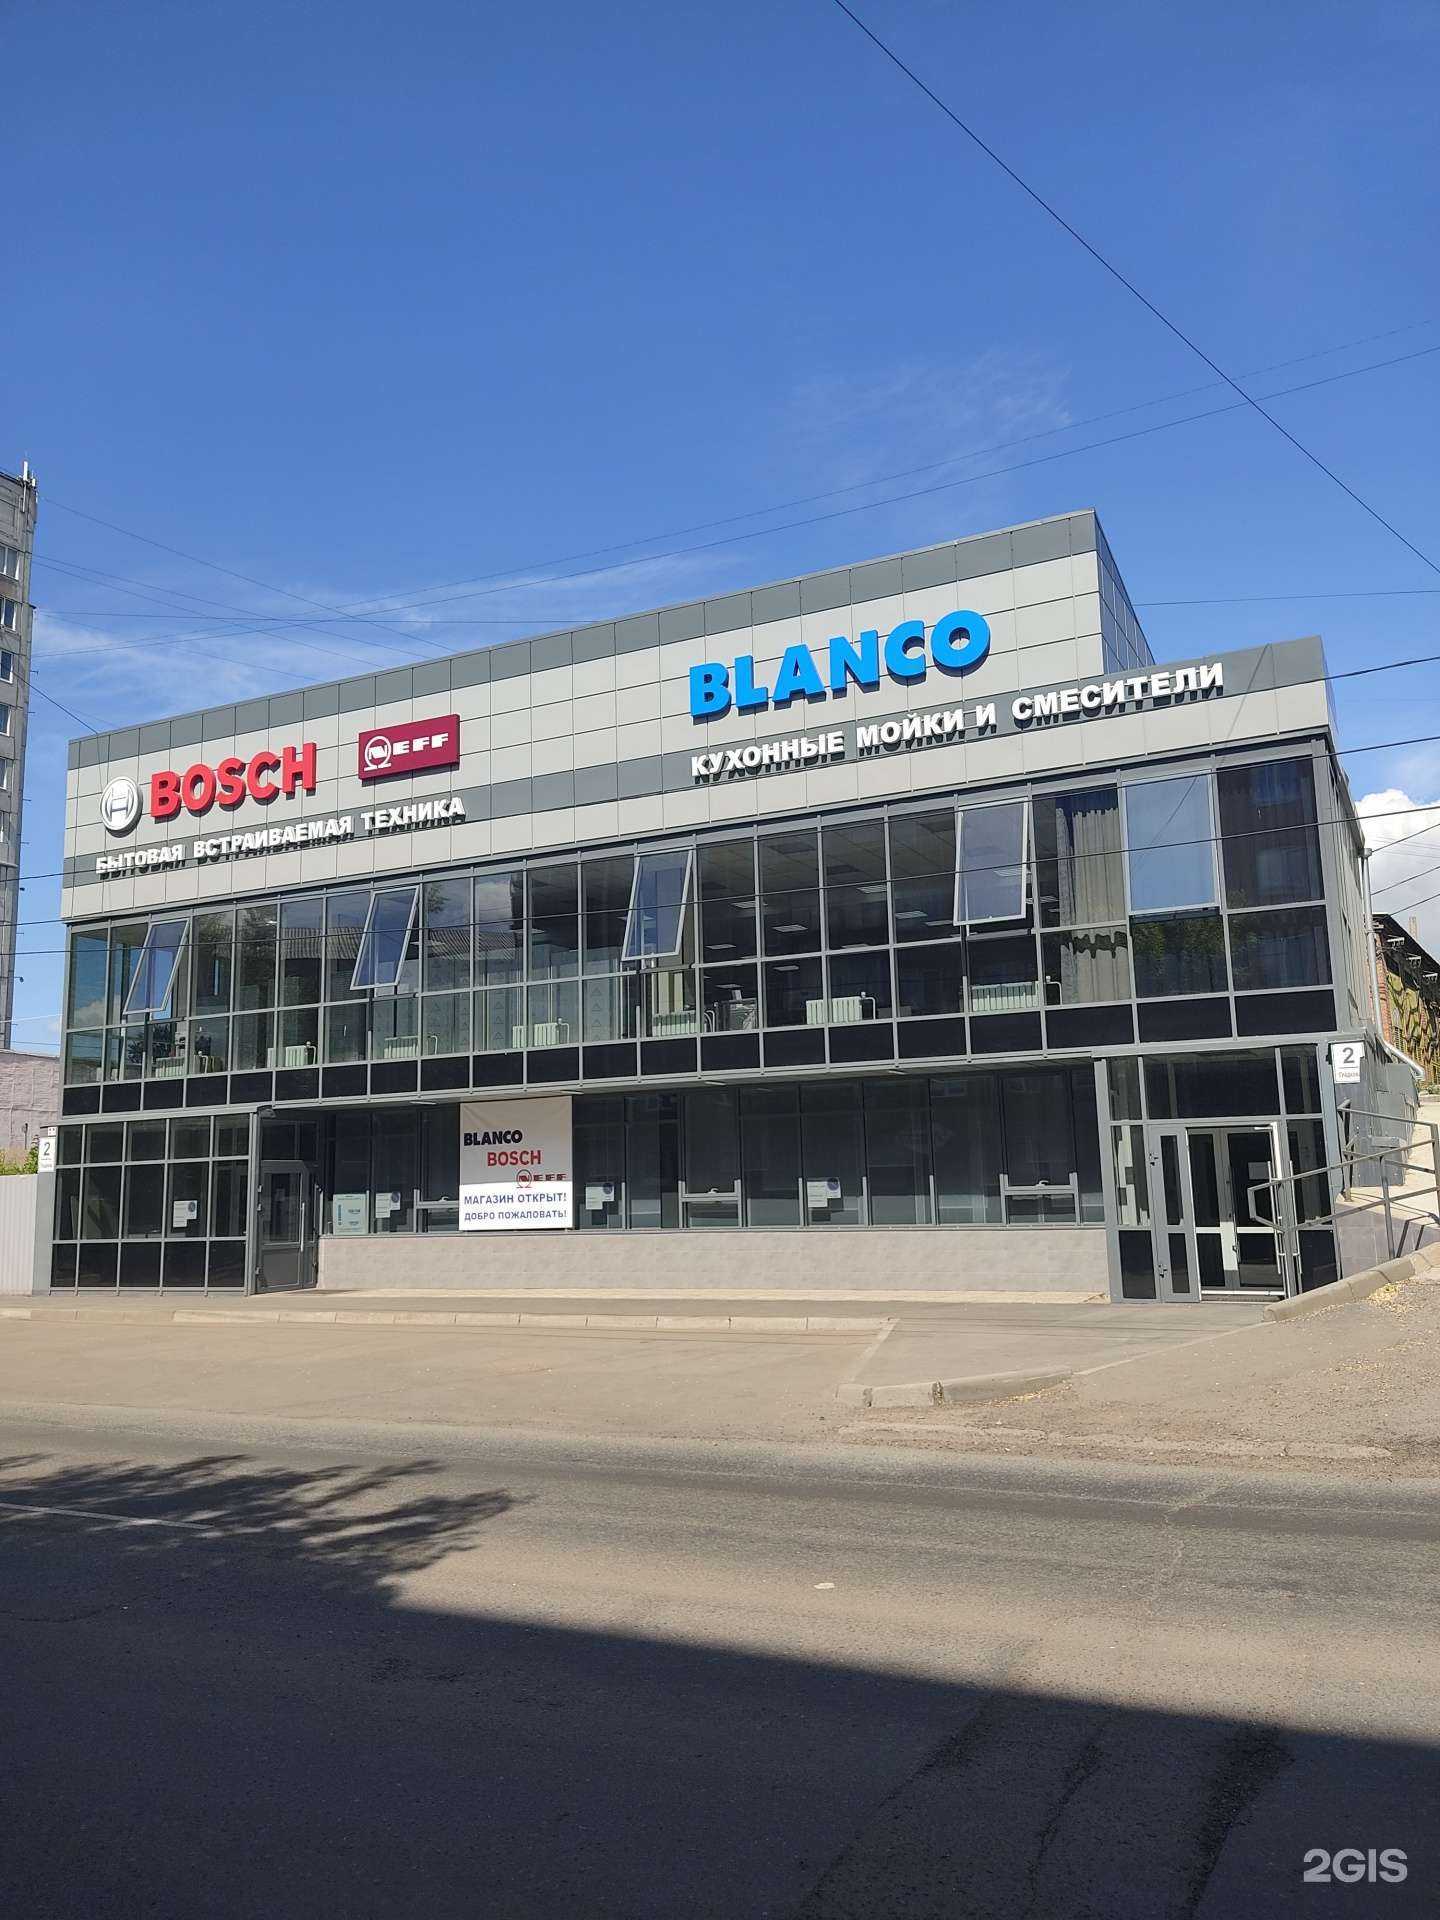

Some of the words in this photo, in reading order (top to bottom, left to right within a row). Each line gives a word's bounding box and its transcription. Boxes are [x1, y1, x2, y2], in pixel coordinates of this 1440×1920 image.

[690, 610, 991, 718] BLANCO
[691, 731, 845, 776] КУХОННЫЕ
[856, 708, 965, 748] МОЙКИ
[976, 703, 997, 728] И
[1012, 662, 1224, 721] СМЕСИТЕЛИ
[366, 733, 449, 765] NEFF
[150, 742, 317, 817] BOSCH
[96, 844, 185, 874] БЫТОВАЯ
[193, 816, 353, 858] ВСТРАИВАЕМАЯ
[361, 797, 466, 830] ТЕХНИКА
[1342, 1047, 1355, 1064] 2
[463, 1130, 523, 1146] BLANCO
[43, 1142, 51, 1156] 2
[487, 1150, 541, 1167] BOSCH
[464, 1194, 514, 1205] МАГАЗИН
[517, 1192, 567, 1203] ОТКРЫТ!
[464, 1212, 496, 1222] ДОБРО
[498, 1210, 567, 1220] ПОЖАЛОВАТЬ!
